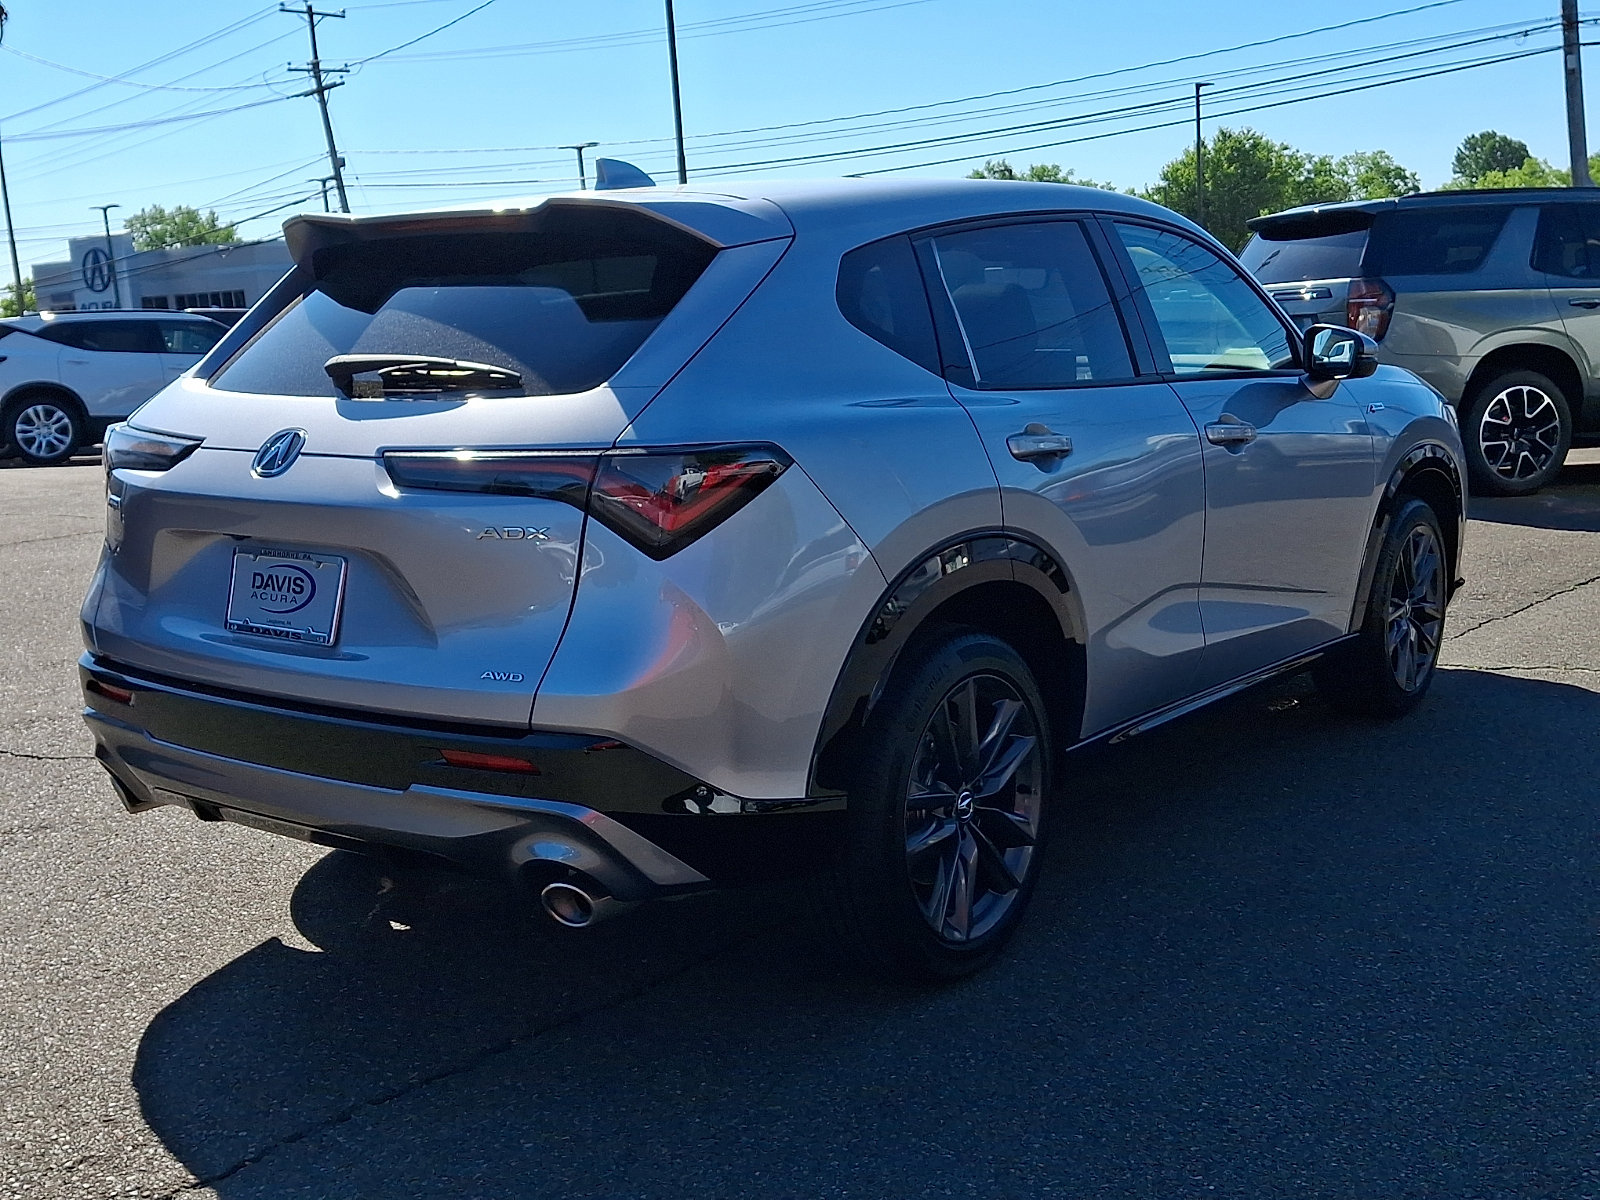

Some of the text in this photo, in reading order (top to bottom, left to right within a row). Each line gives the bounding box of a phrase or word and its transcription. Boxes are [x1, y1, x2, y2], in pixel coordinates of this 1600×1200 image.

[476, 526, 550, 540] ADX
[251, 571, 305, 595] DAVIS
[250, 591, 298, 605] ACURA
[252, 627, 303, 639] DAVIS
[480, 671, 524, 683] AWD
